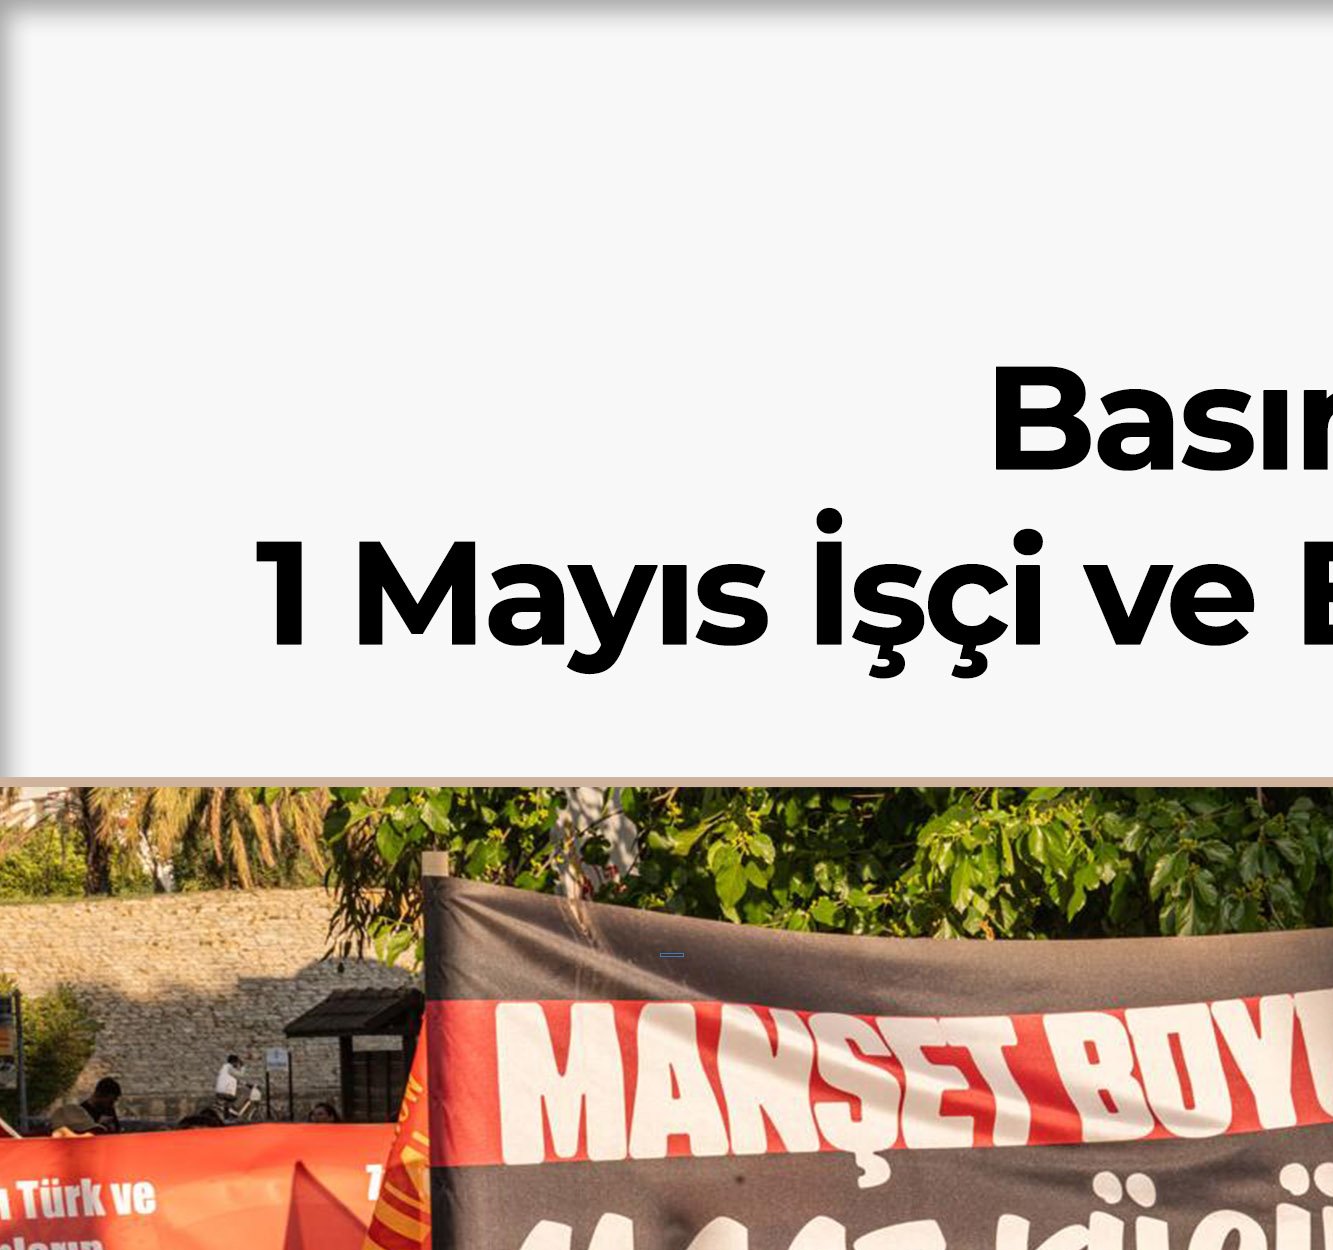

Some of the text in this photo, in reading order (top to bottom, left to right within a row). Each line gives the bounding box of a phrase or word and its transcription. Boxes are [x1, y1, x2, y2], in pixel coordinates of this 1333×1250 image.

[495, 1001, 1031, 1189] MANŞET
[16, 1177, 106, 1220] Türk
[110, 1180, 157, 1216] ve
